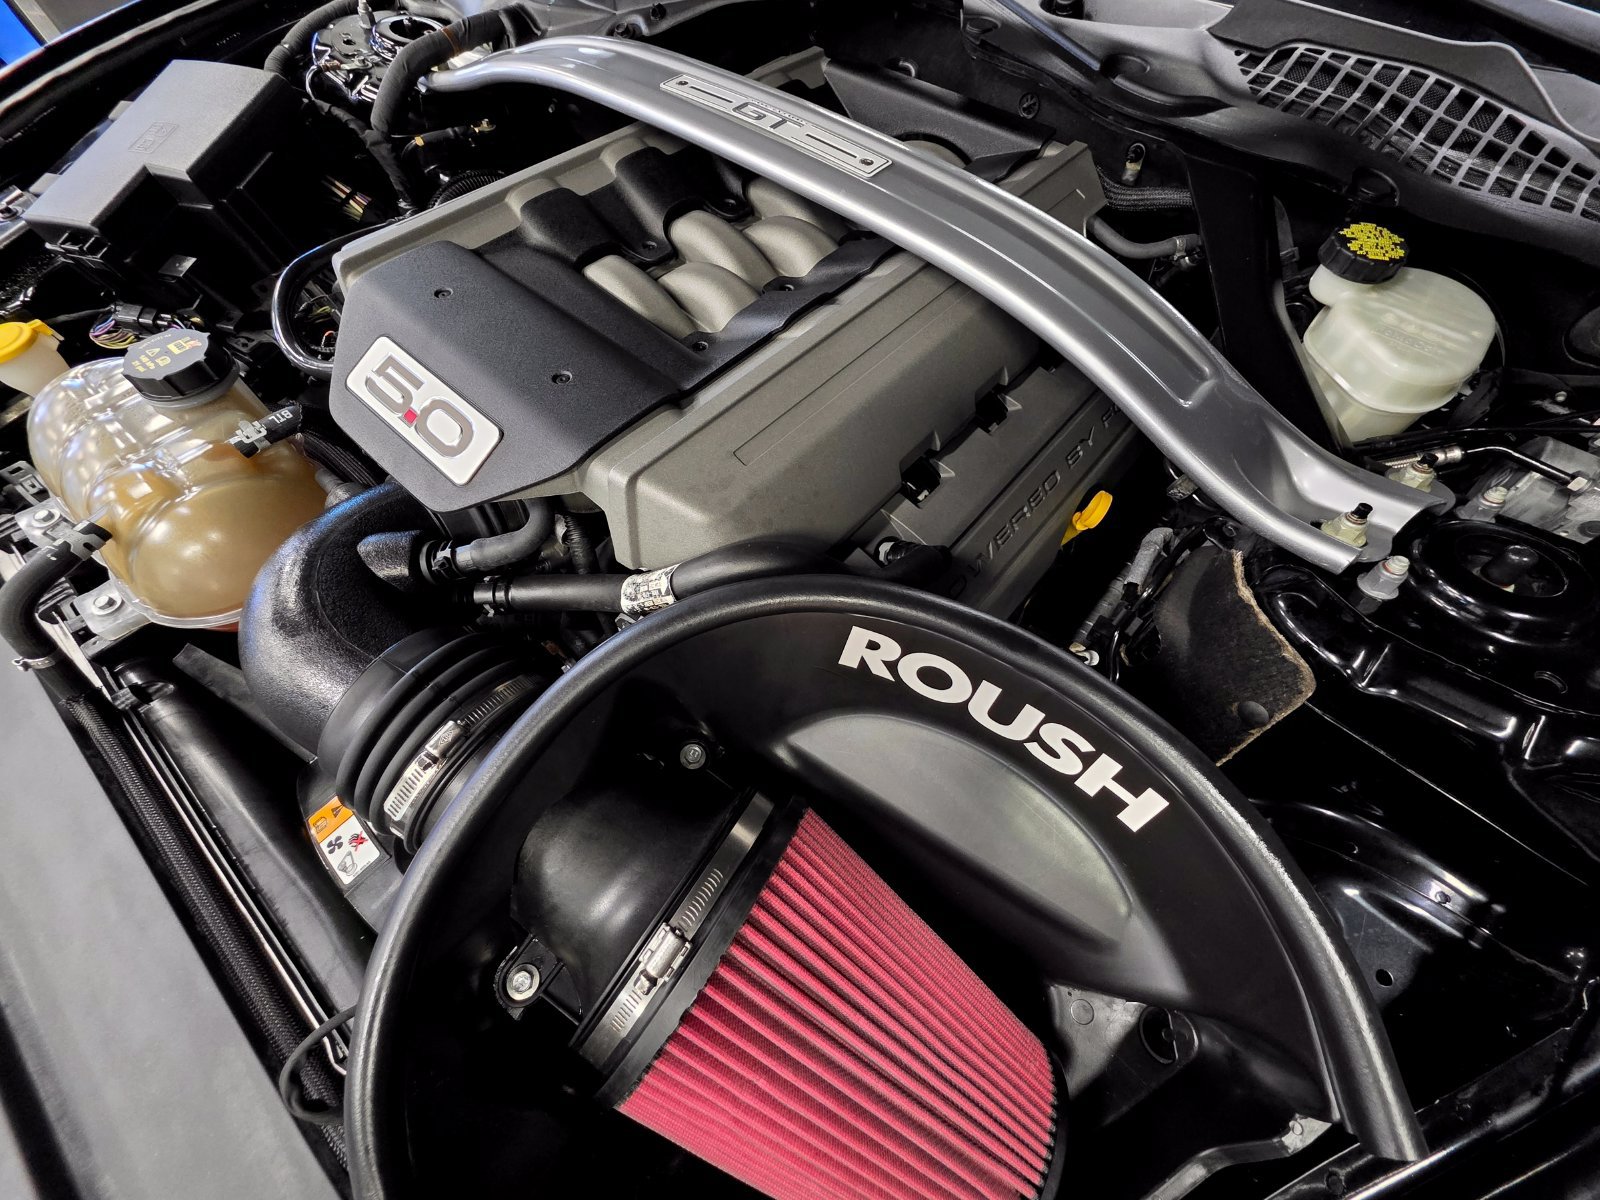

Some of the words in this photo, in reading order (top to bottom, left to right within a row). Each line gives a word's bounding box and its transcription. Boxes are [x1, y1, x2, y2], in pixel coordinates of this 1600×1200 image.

[732, 102, 805, 129] GT
[365, 354, 474, 458] 5.0
[948, 470, 1061, 600] OWERED
[1065, 426, 1095, 469] BY
[838, 625, 1170, 833] ROUSH
